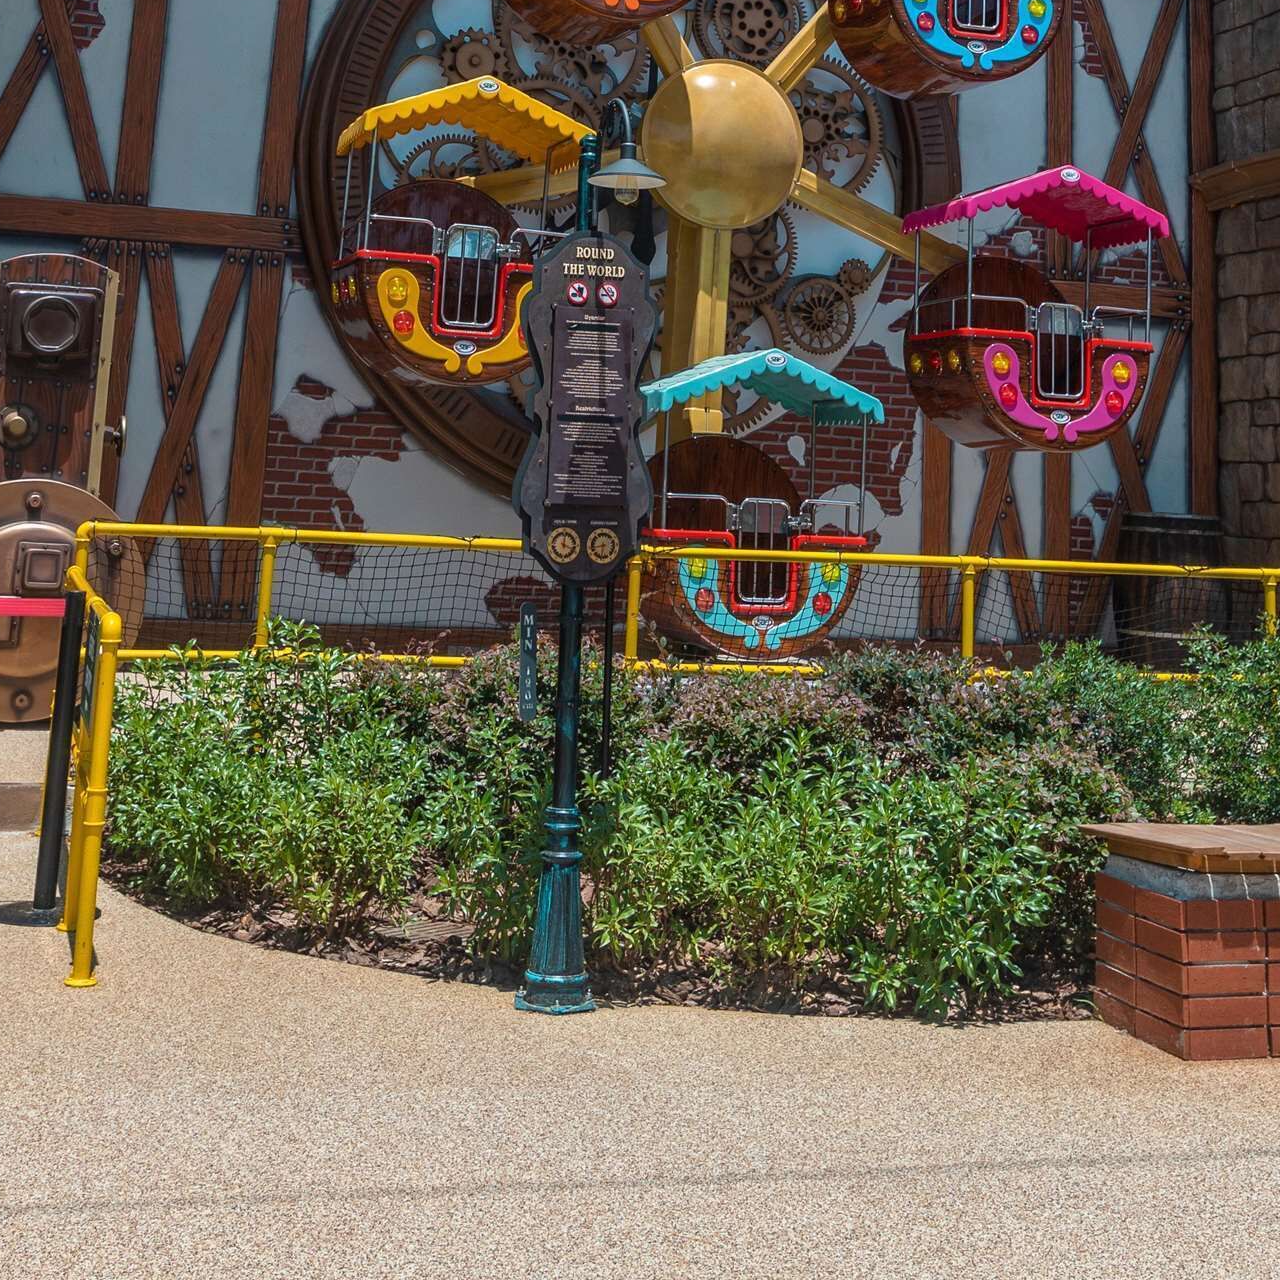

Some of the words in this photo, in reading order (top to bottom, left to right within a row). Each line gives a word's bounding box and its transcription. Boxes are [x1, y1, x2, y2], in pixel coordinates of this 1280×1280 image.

[576, 246, 615, 260] ROUND
[563, 263, 585, 275] THE
[586, 264, 625, 278] WORLD
[523, 614, 534, 650] MIN
